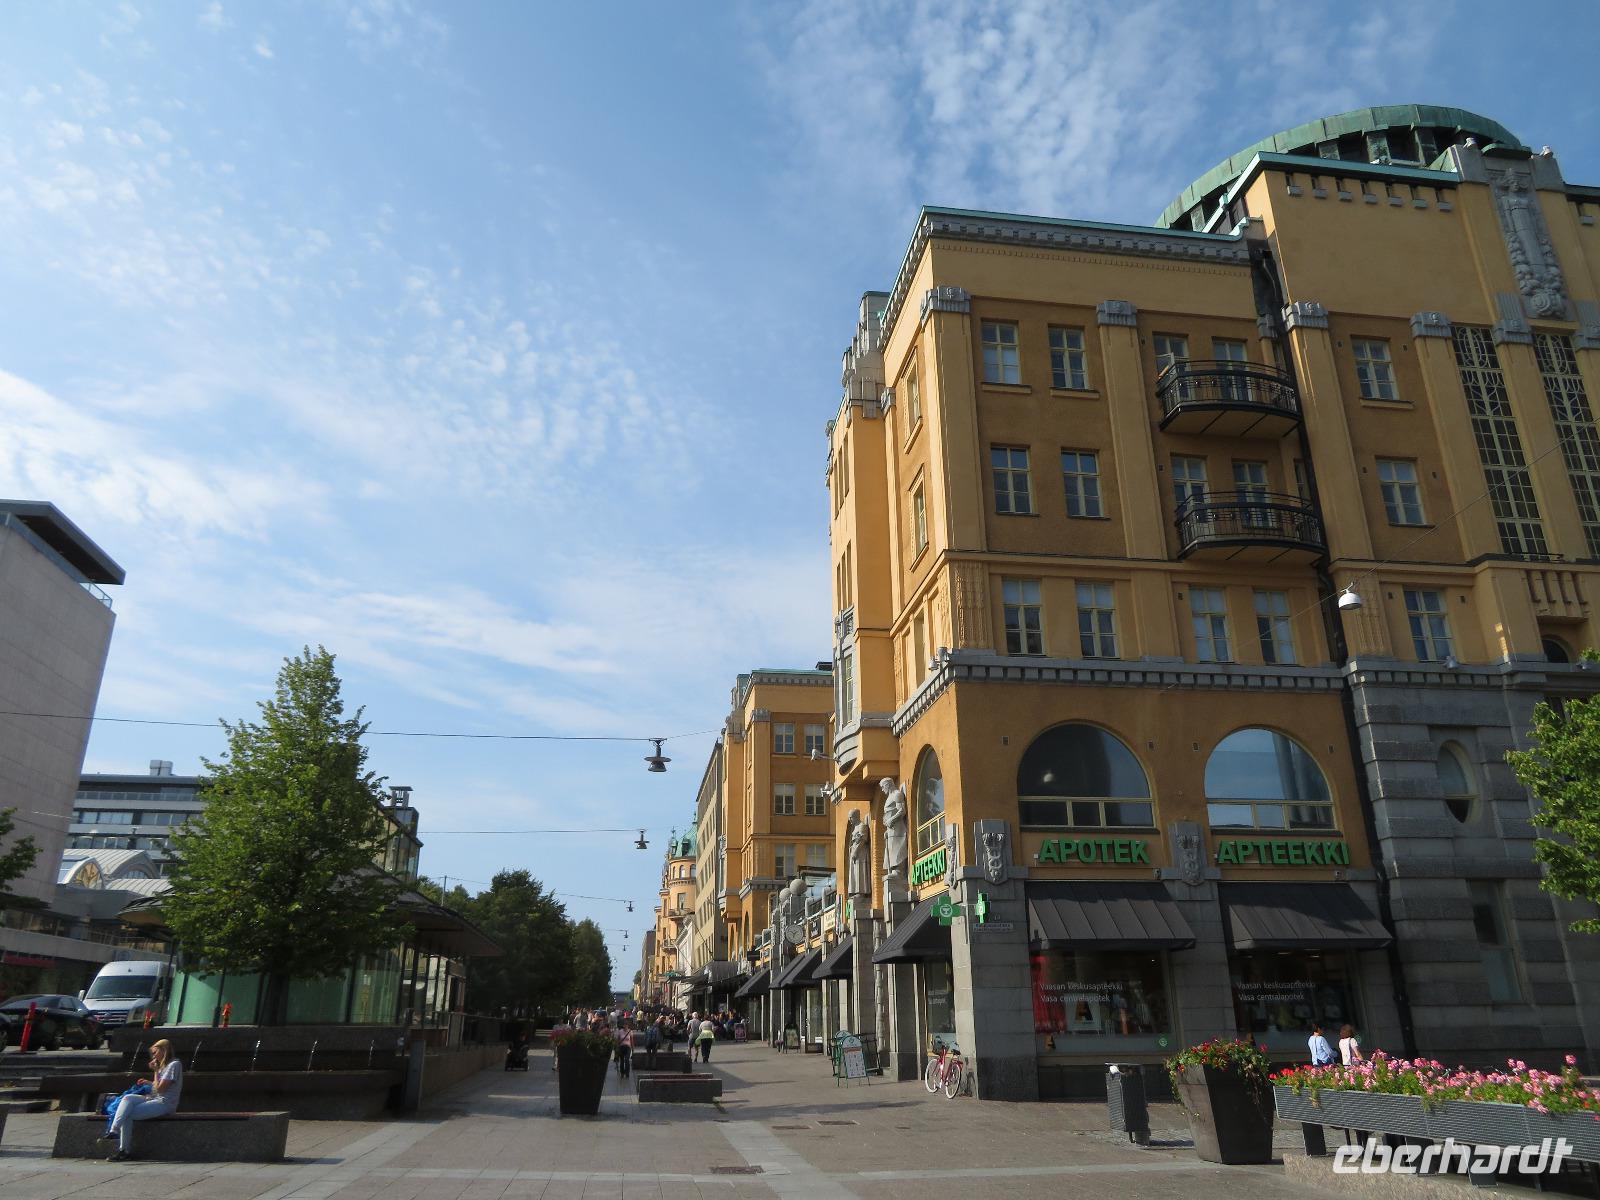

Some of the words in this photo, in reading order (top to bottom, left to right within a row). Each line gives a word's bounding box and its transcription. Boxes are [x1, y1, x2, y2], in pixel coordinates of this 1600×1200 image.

[1039, 839, 1150, 864] APOTEK
[1217, 839, 1350, 865] APTEEKKI
[911, 848, 946, 886] APTEEKKI
[1040, 983, 1066, 991] Vaasan
[1068, 982, 1123, 991] keskusapteekki
[1237, 982, 1262, 990] Vaasan
[1040, 994, 1058, 1002] Vasa
[1238, 993, 1255, 1001] Vasa
